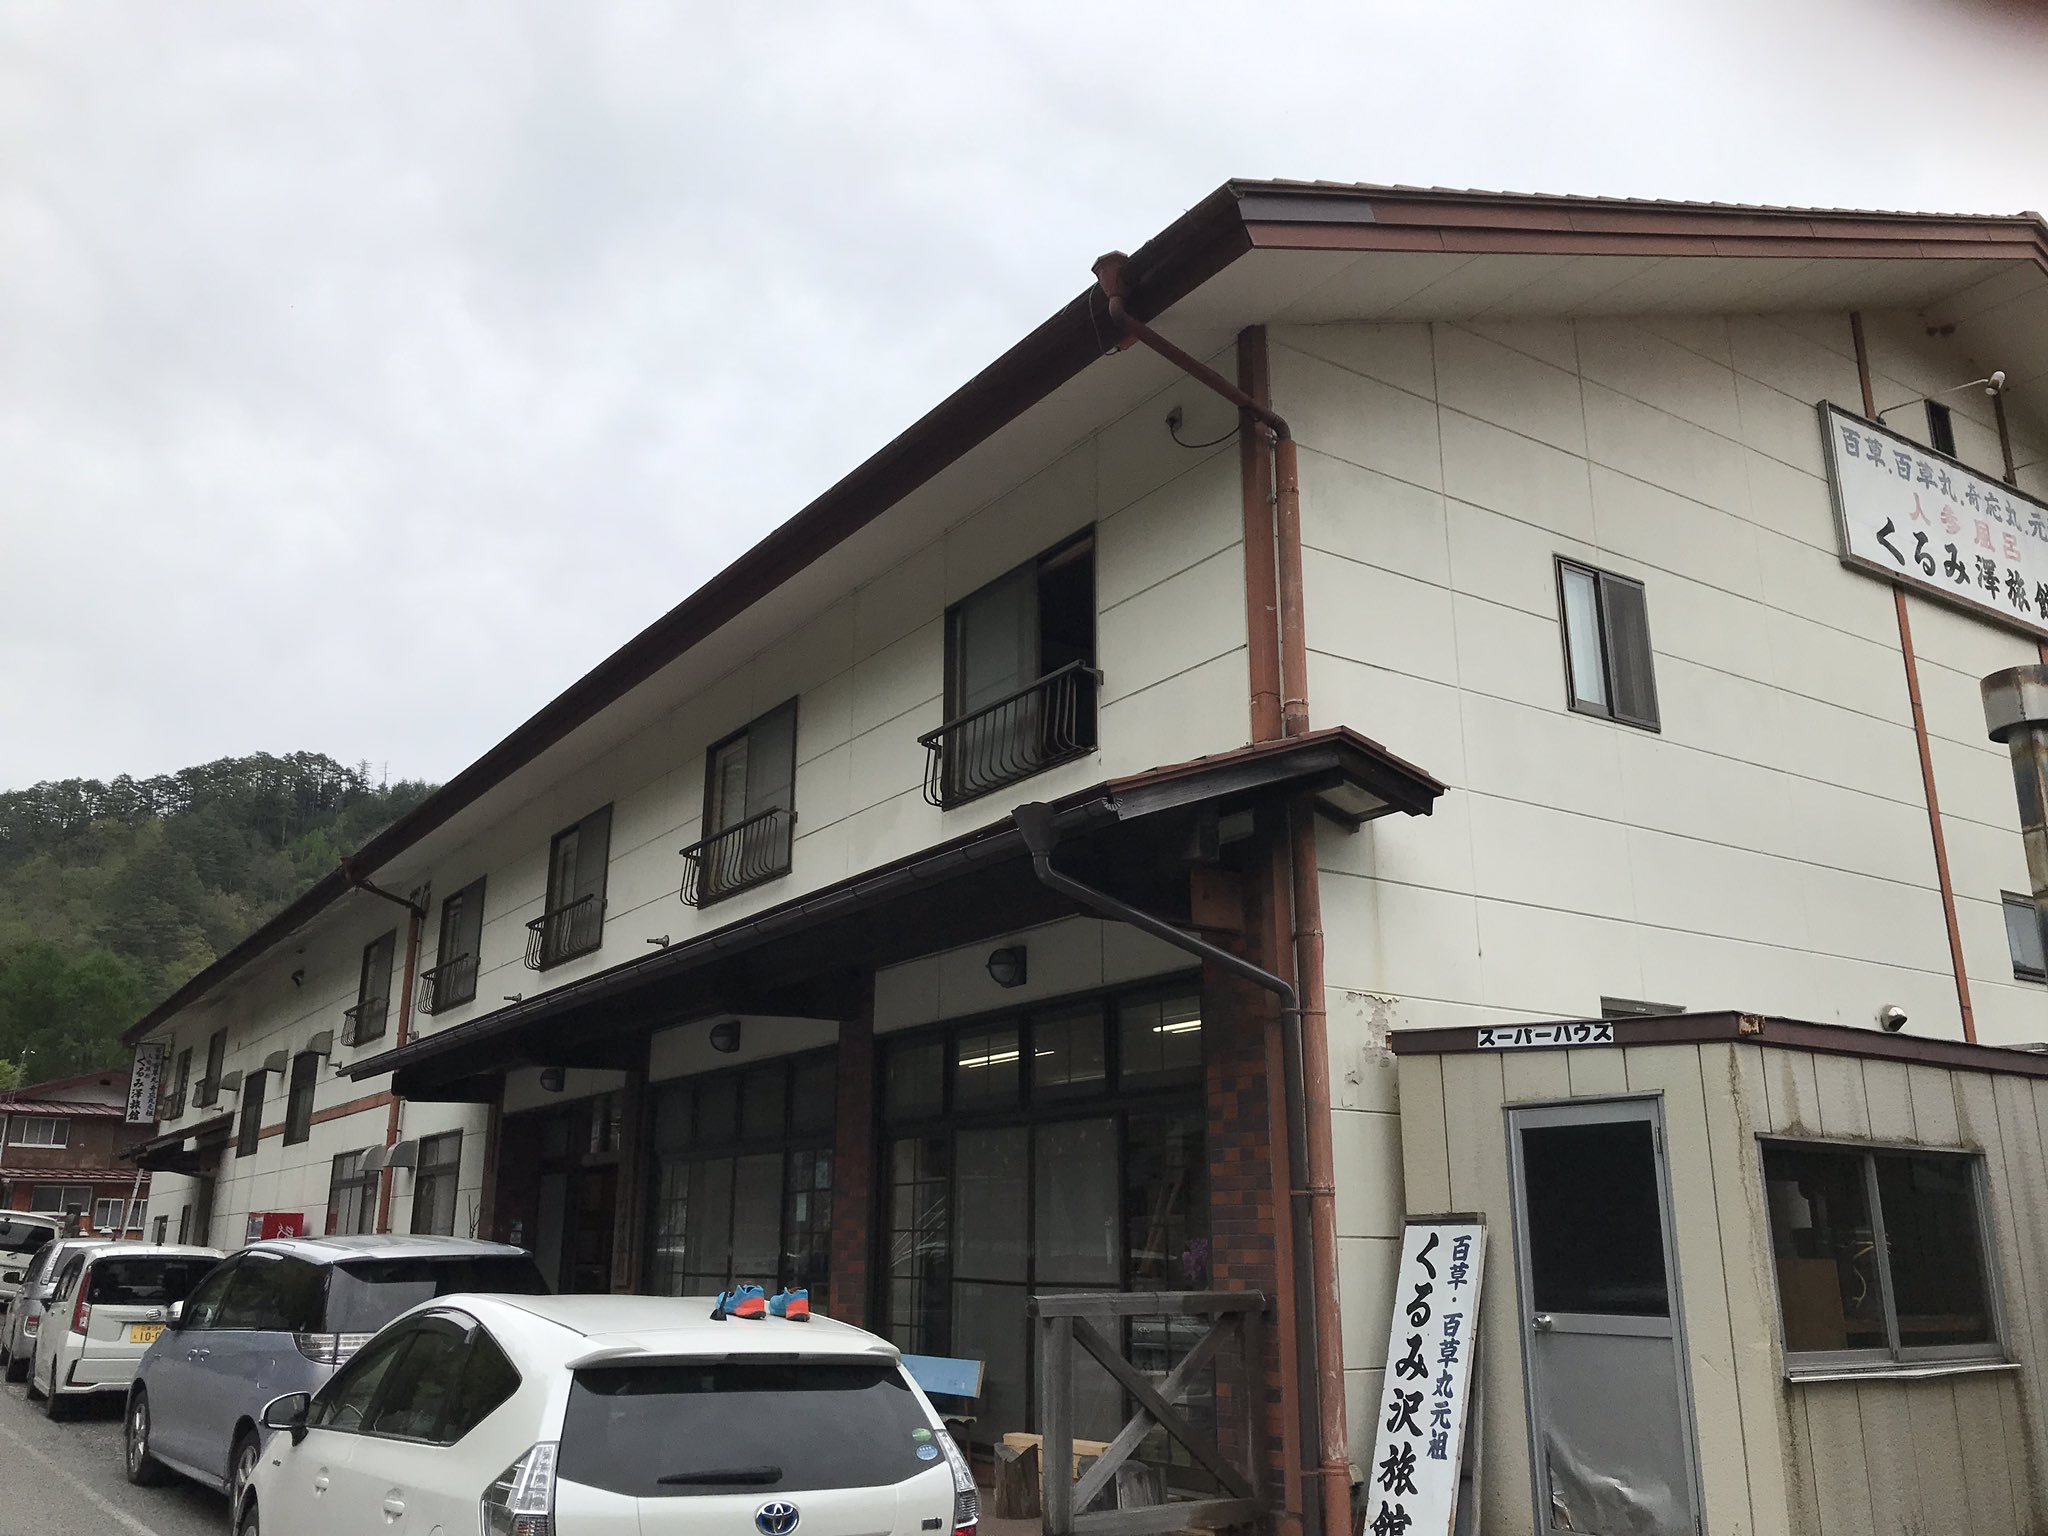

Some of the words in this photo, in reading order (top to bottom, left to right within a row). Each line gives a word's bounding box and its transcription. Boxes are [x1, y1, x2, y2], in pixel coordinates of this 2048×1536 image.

[1479, 1024, 1612, 1046] スーパーハウス
[1370, 1232, 1439, 1536] くるみ沢旅館
